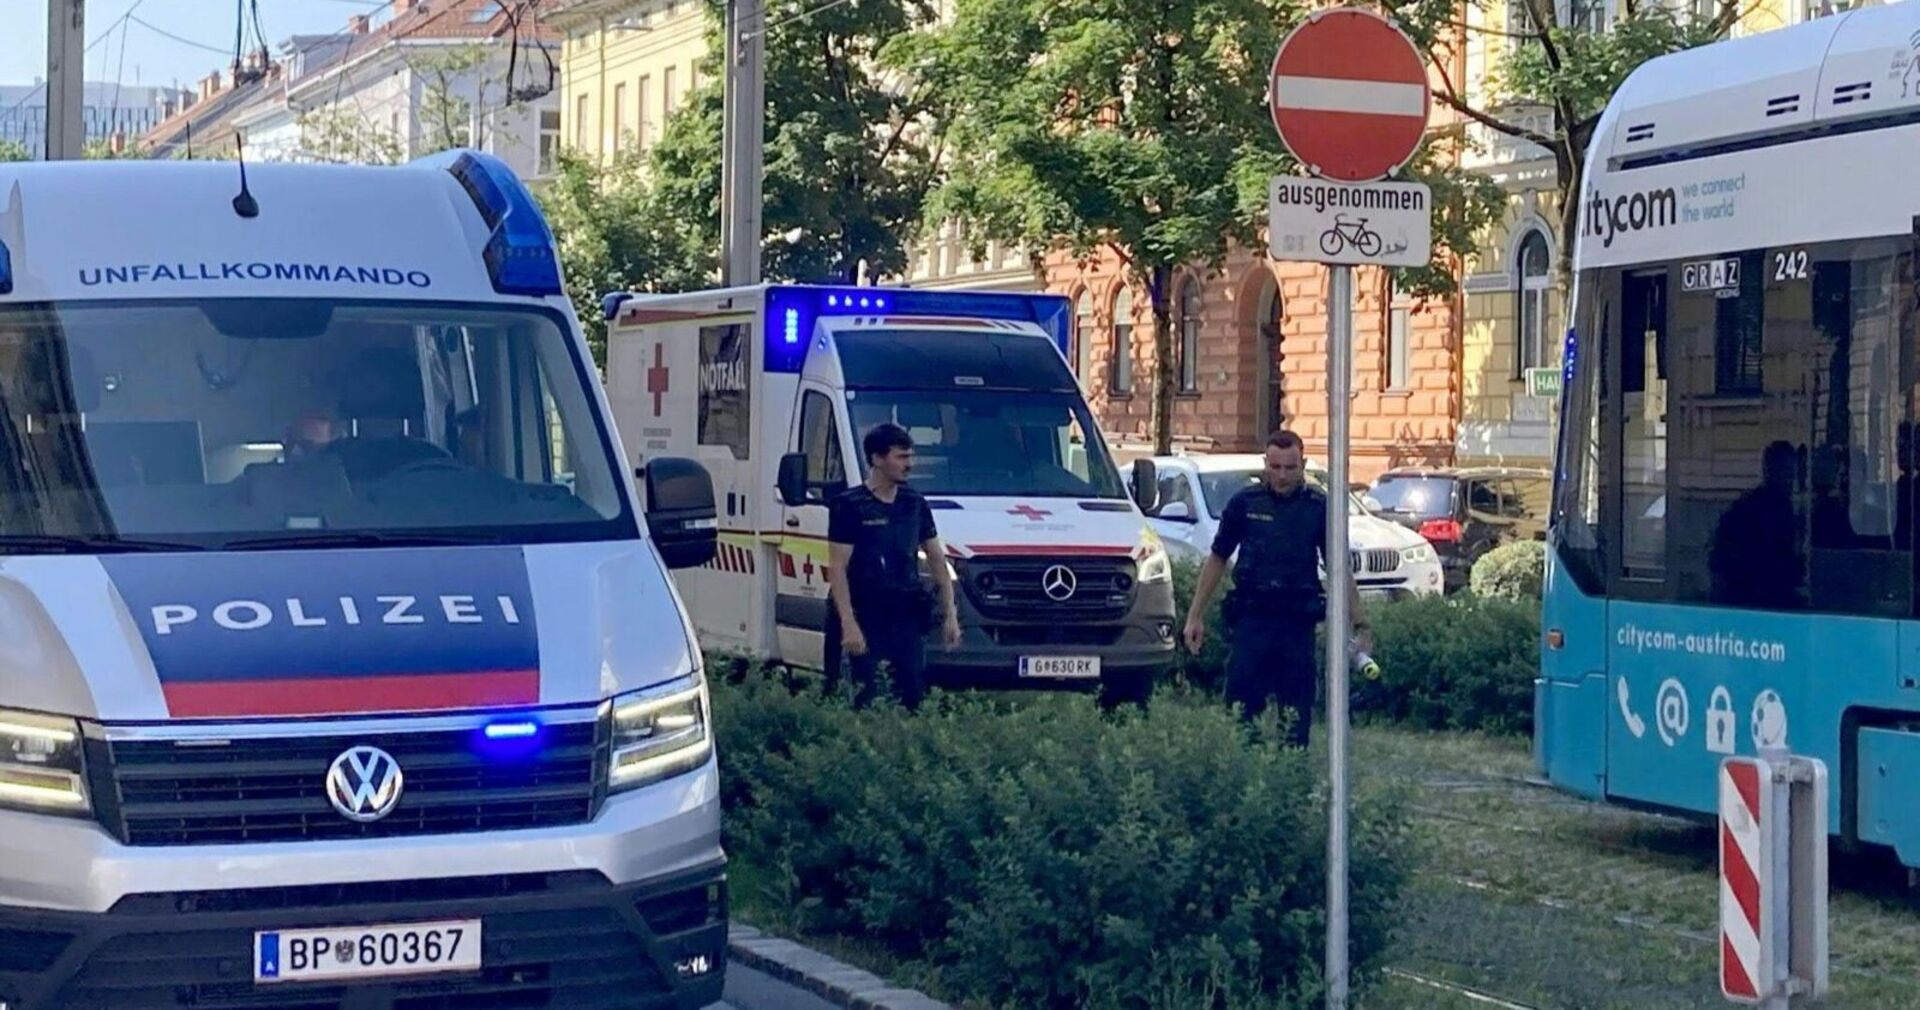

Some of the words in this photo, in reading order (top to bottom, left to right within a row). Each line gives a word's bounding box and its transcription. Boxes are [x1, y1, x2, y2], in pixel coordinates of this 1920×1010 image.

[1278, 184, 1424, 213] ausgenommen
[1681, 183, 1699, 198] we
[1701, 172, 1746, 196] connect
[1581, 180, 1677, 248] itycom
[1681, 202, 1699, 223] the
[1702, 198, 1735, 218] world
[79, 262, 432, 288] UNFALLKOMMANDO
[1683, 261, 1738, 289] GRAZ
[1775, 251, 1808, 281] 242
[700, 361, 746, 392] NOTFALL
[151, 595, 520, 635] POLIZEI
[1617, 623, 1786, 662] citycom-austria.com
[1035, 660, 1043, 673] G
[1051, 660, 1075, 673] 630
[1077, 660, 1092, 673] RK
[264, 961, 275, 972] A
[290, 937, 331, 970] BP
[359, 929, 464, 966] 60367
